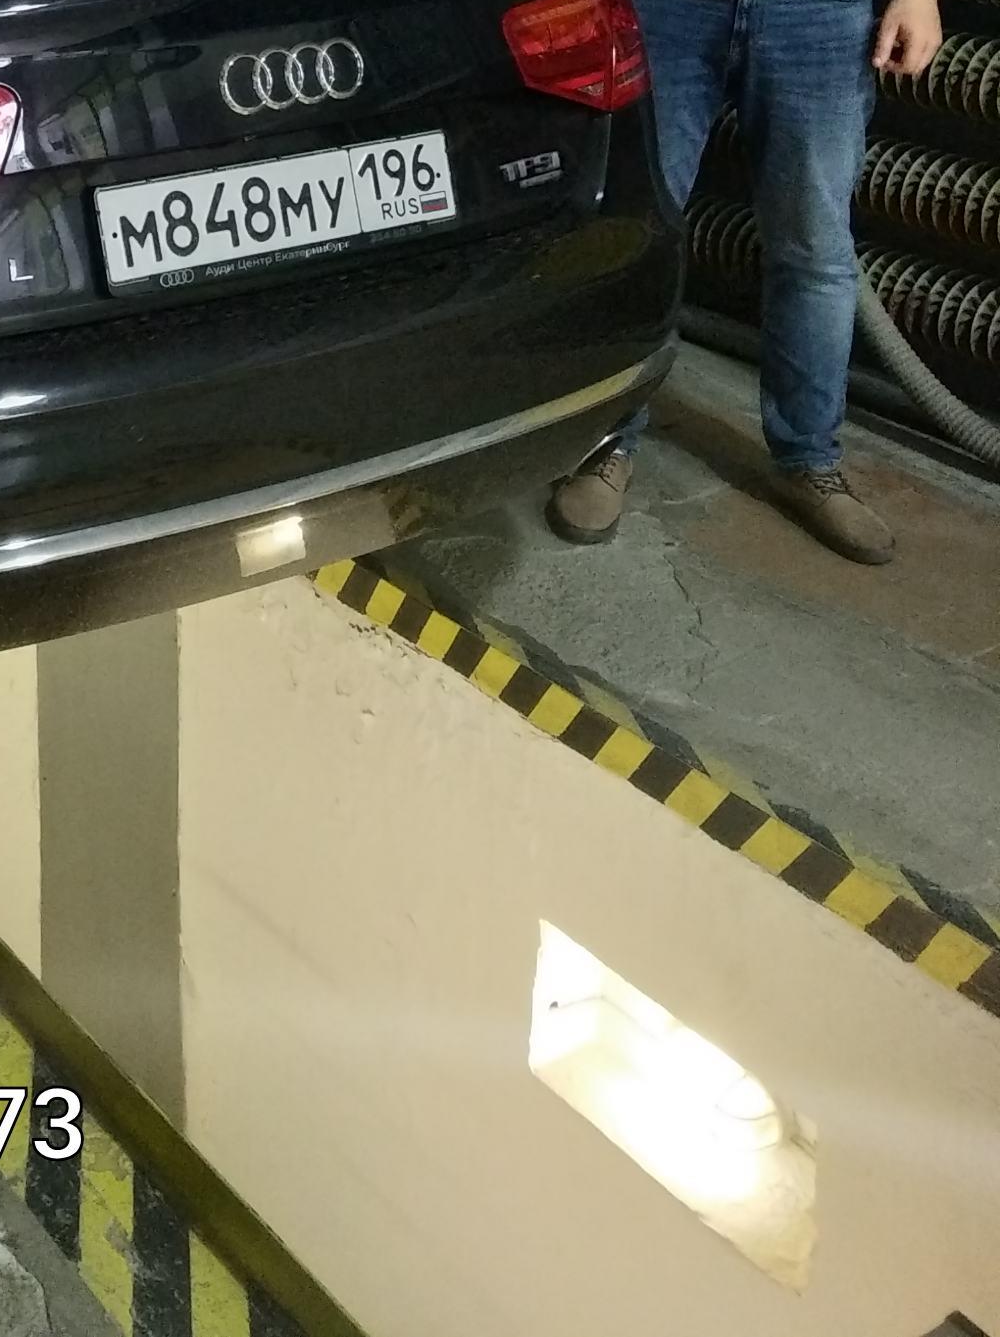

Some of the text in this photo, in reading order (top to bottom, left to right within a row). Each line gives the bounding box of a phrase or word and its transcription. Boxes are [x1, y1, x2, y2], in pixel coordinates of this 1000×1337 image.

[357, 143, 435, 201] 196
[119, 176, 346, 269] М848МУ
[381, 197, 419, 220] RUS
[205, 263, 235, 278] Ауди
[238, 255, 273, 272] Центр
